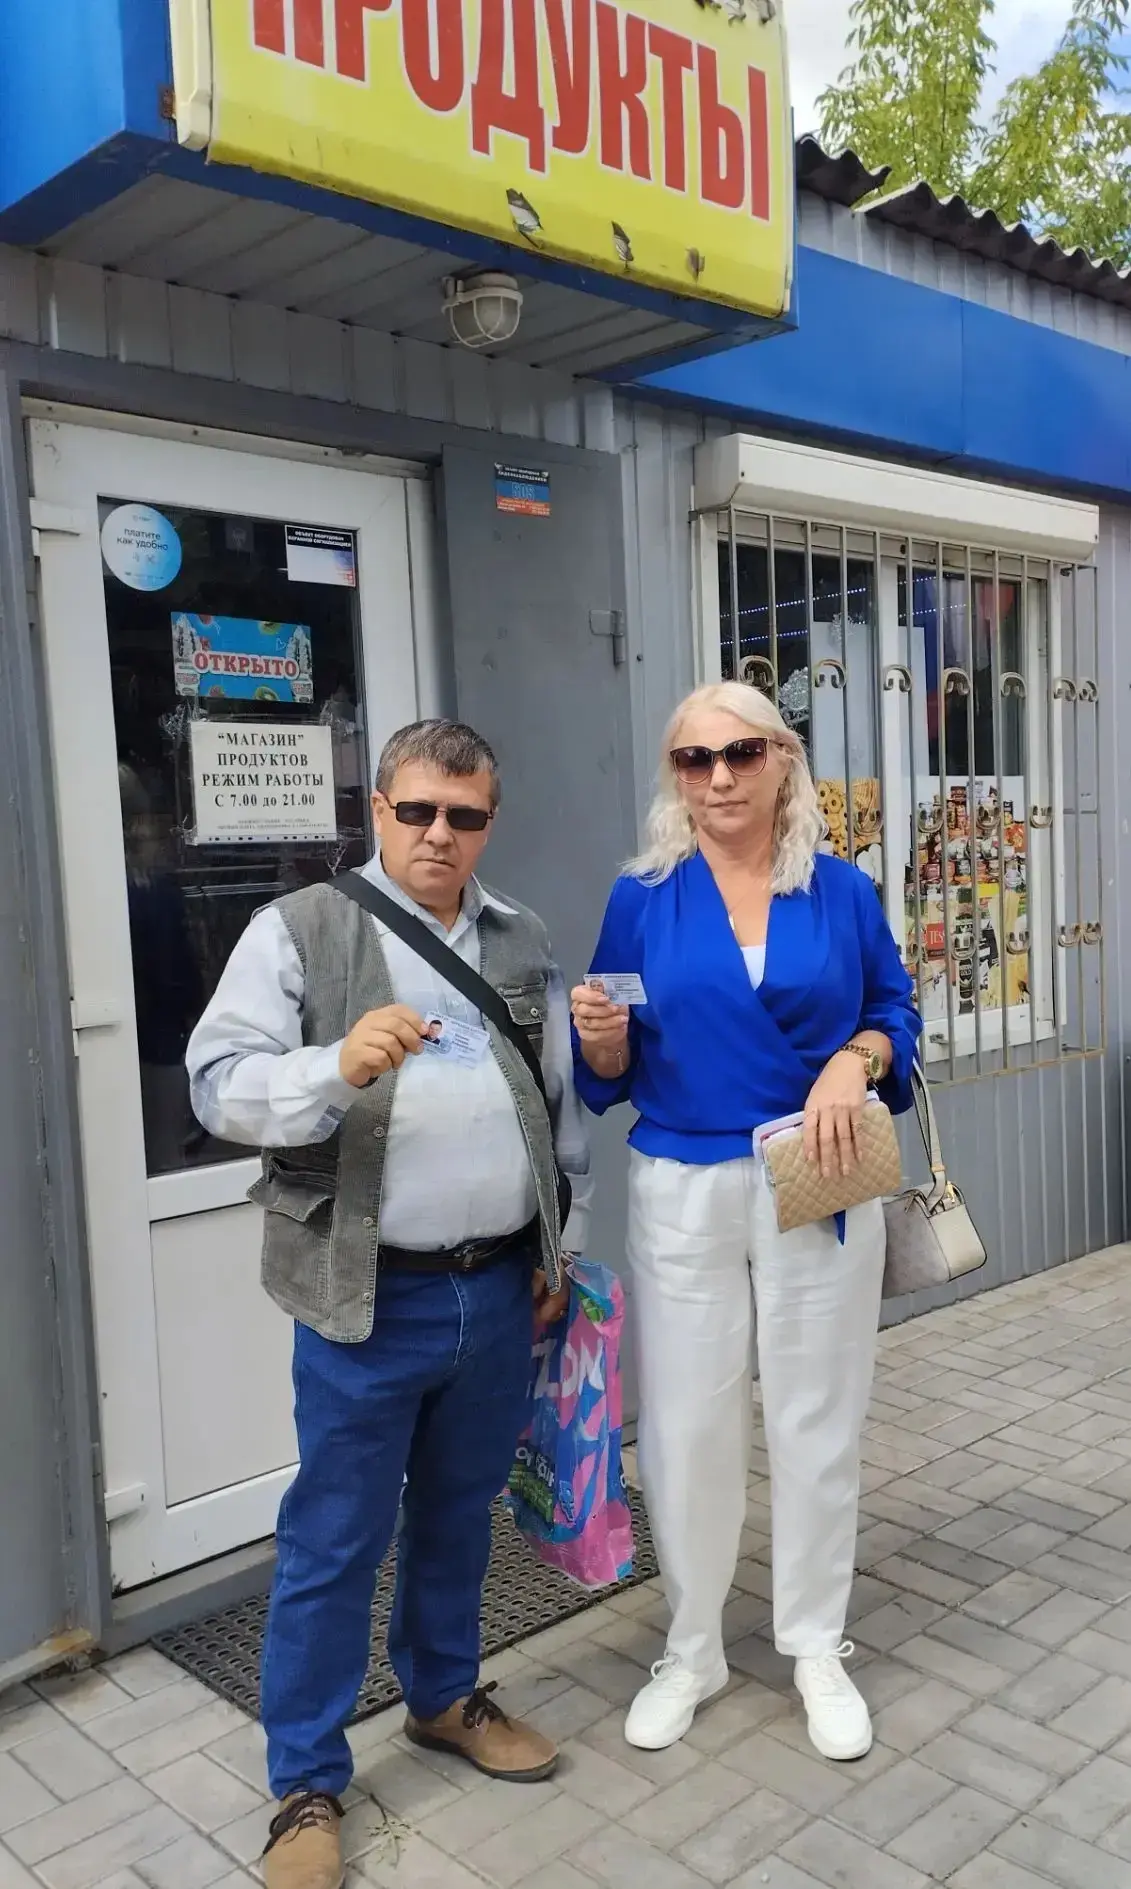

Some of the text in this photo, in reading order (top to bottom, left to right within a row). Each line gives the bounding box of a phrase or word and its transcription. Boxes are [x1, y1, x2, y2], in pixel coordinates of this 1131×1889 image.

[124, 528, 161, 540] платите
[117, 537, 168, 551] как удобно
[194, 652, 297, 677] ОТКРЫТО
[217, 753, 308, 768] ПРОДУКТОВ
[202, 774, 324, 786] РЕЖИМ РАБОТЫ
[214, 793, 315, 808] С 7.00 до 21.00
[929, 930, 945, 945] TES
